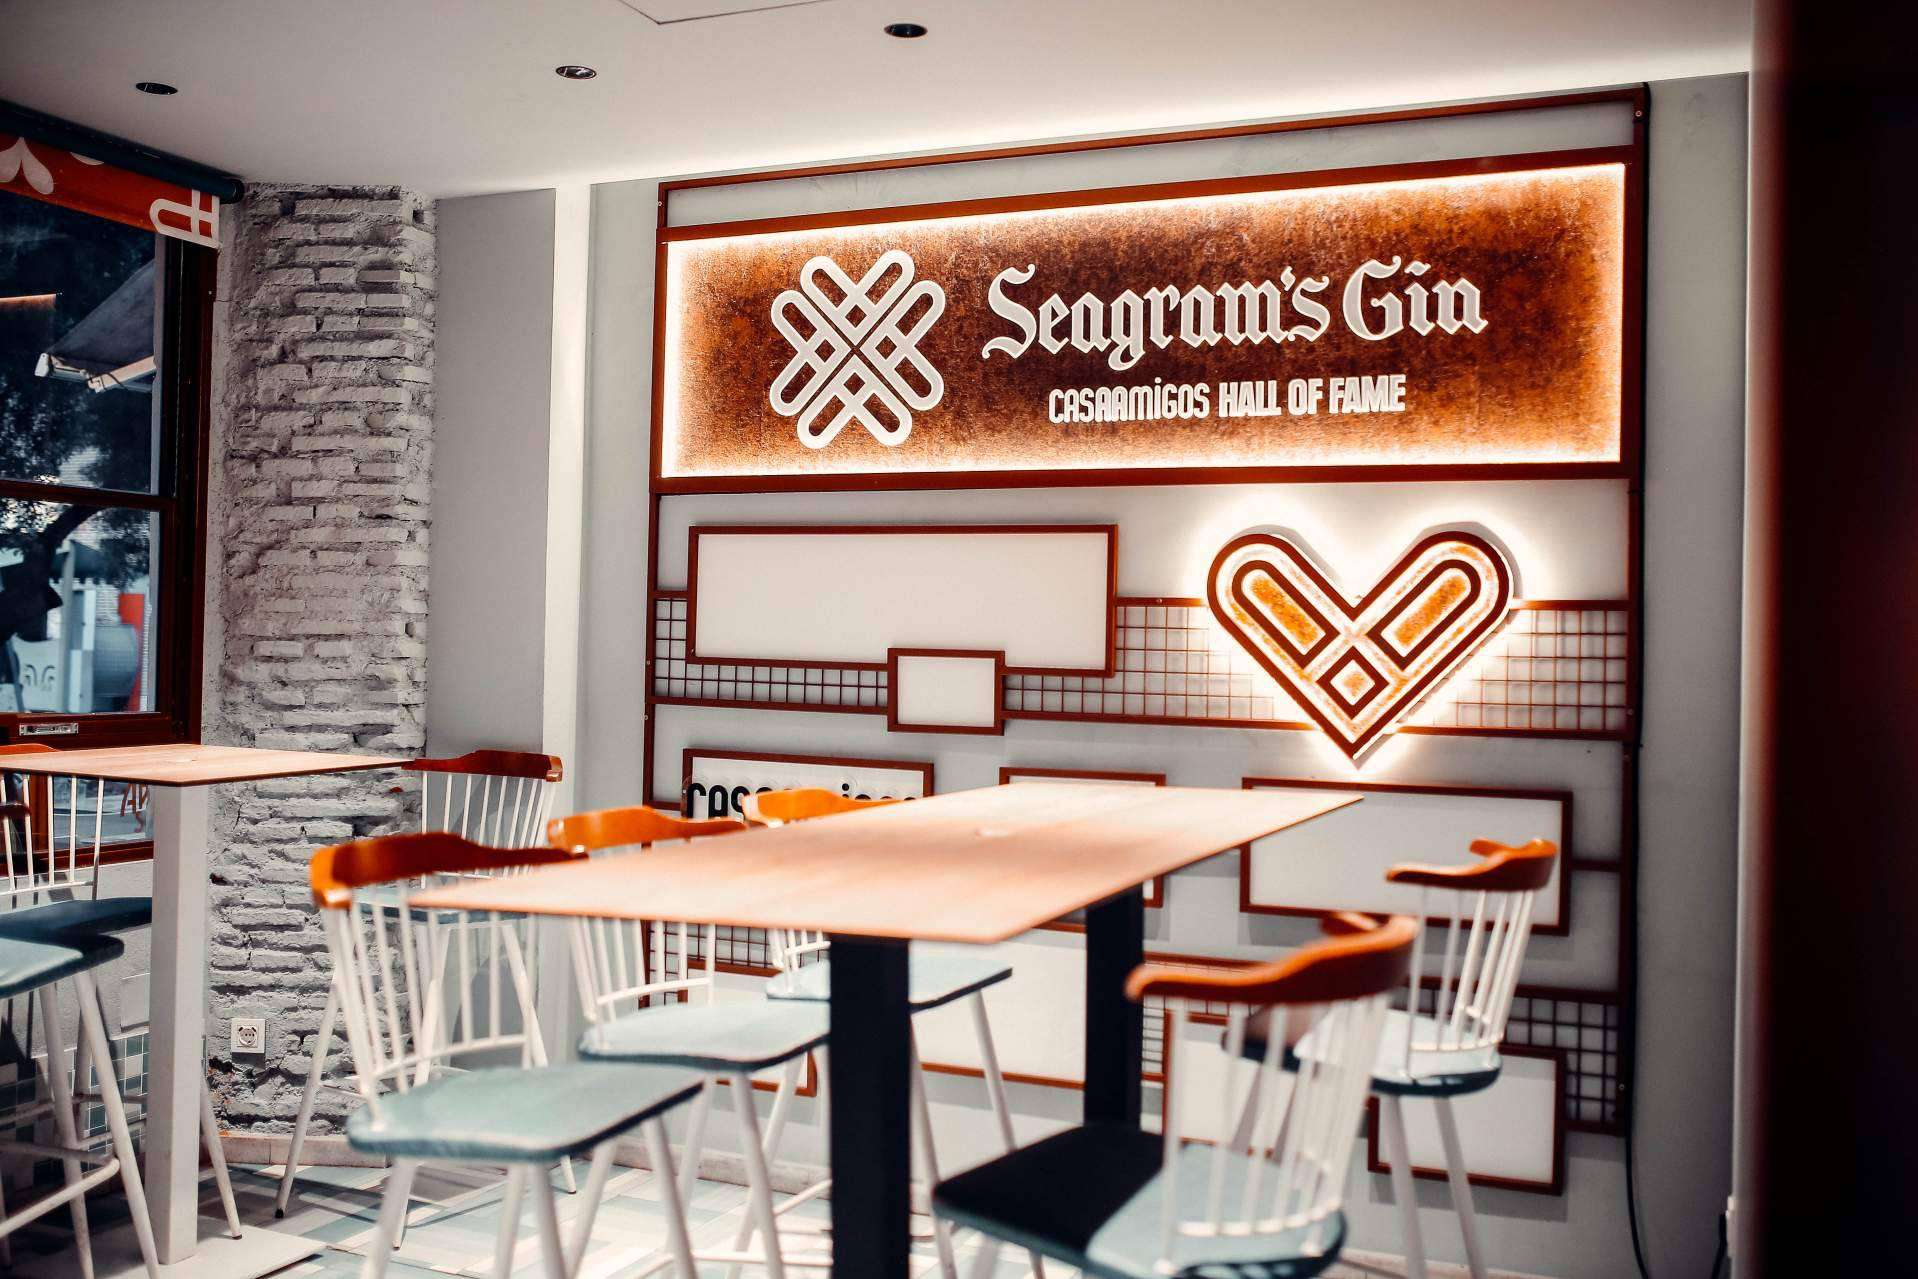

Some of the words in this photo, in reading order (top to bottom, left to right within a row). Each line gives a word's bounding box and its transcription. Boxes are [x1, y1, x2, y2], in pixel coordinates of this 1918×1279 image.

[982, 263, 1330, 371] Seagram's
[1342, 255, 1488, 341] Gin
[1218, 379, 1282, 417] HALL
[1288, 378, 1323, 416] OF
[1328, 374, 1406, 414] FAME
